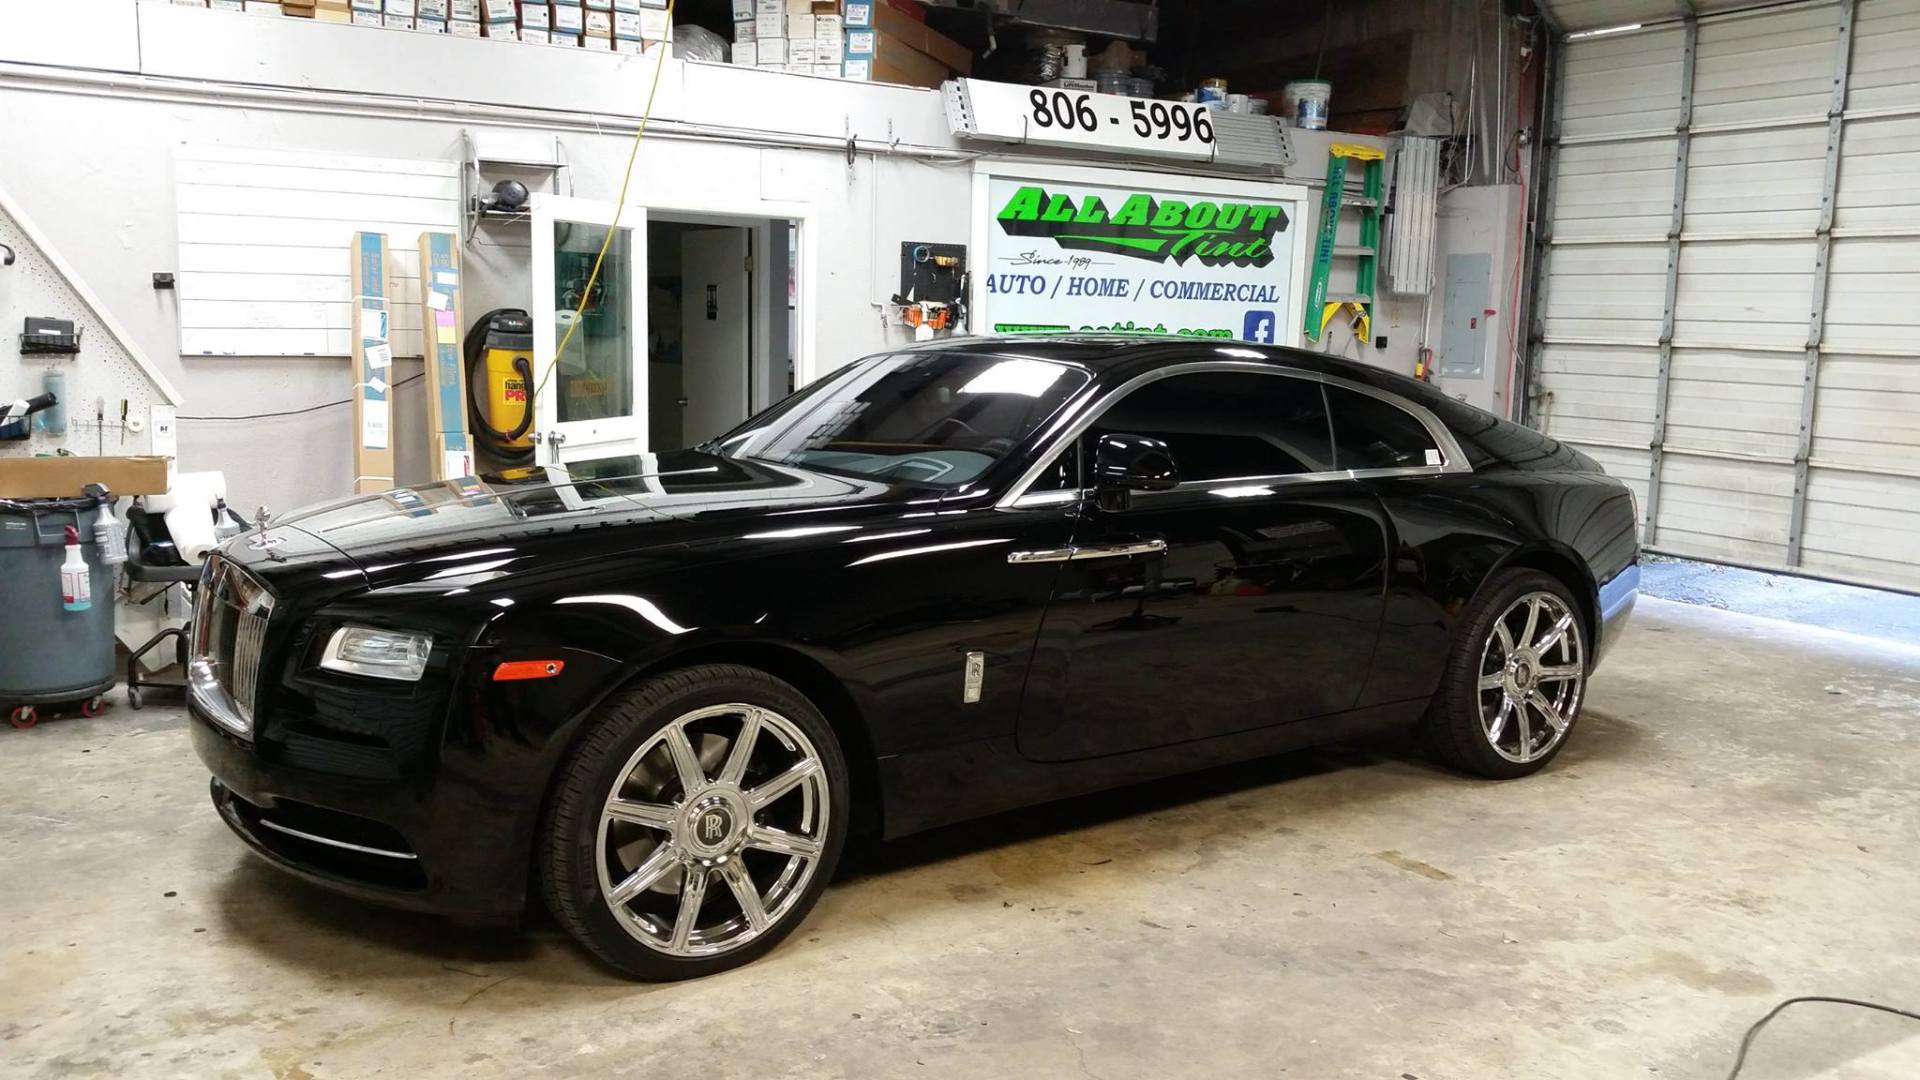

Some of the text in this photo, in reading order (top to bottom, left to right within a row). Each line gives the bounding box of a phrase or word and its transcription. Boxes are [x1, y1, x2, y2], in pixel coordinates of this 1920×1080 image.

[1030, 89, 1097, 132] 806
[1130, 100, 1213, 143] 5996
[997, 187, 1283, 231] ALL ABOUT
[1155, 228, 1271, 258] Tint
[987, 274, 1046, 295] AUTO
[1066, 277, 1130, 298] HOME
[1150, 280, 1280, 303] COMMERCIAL
